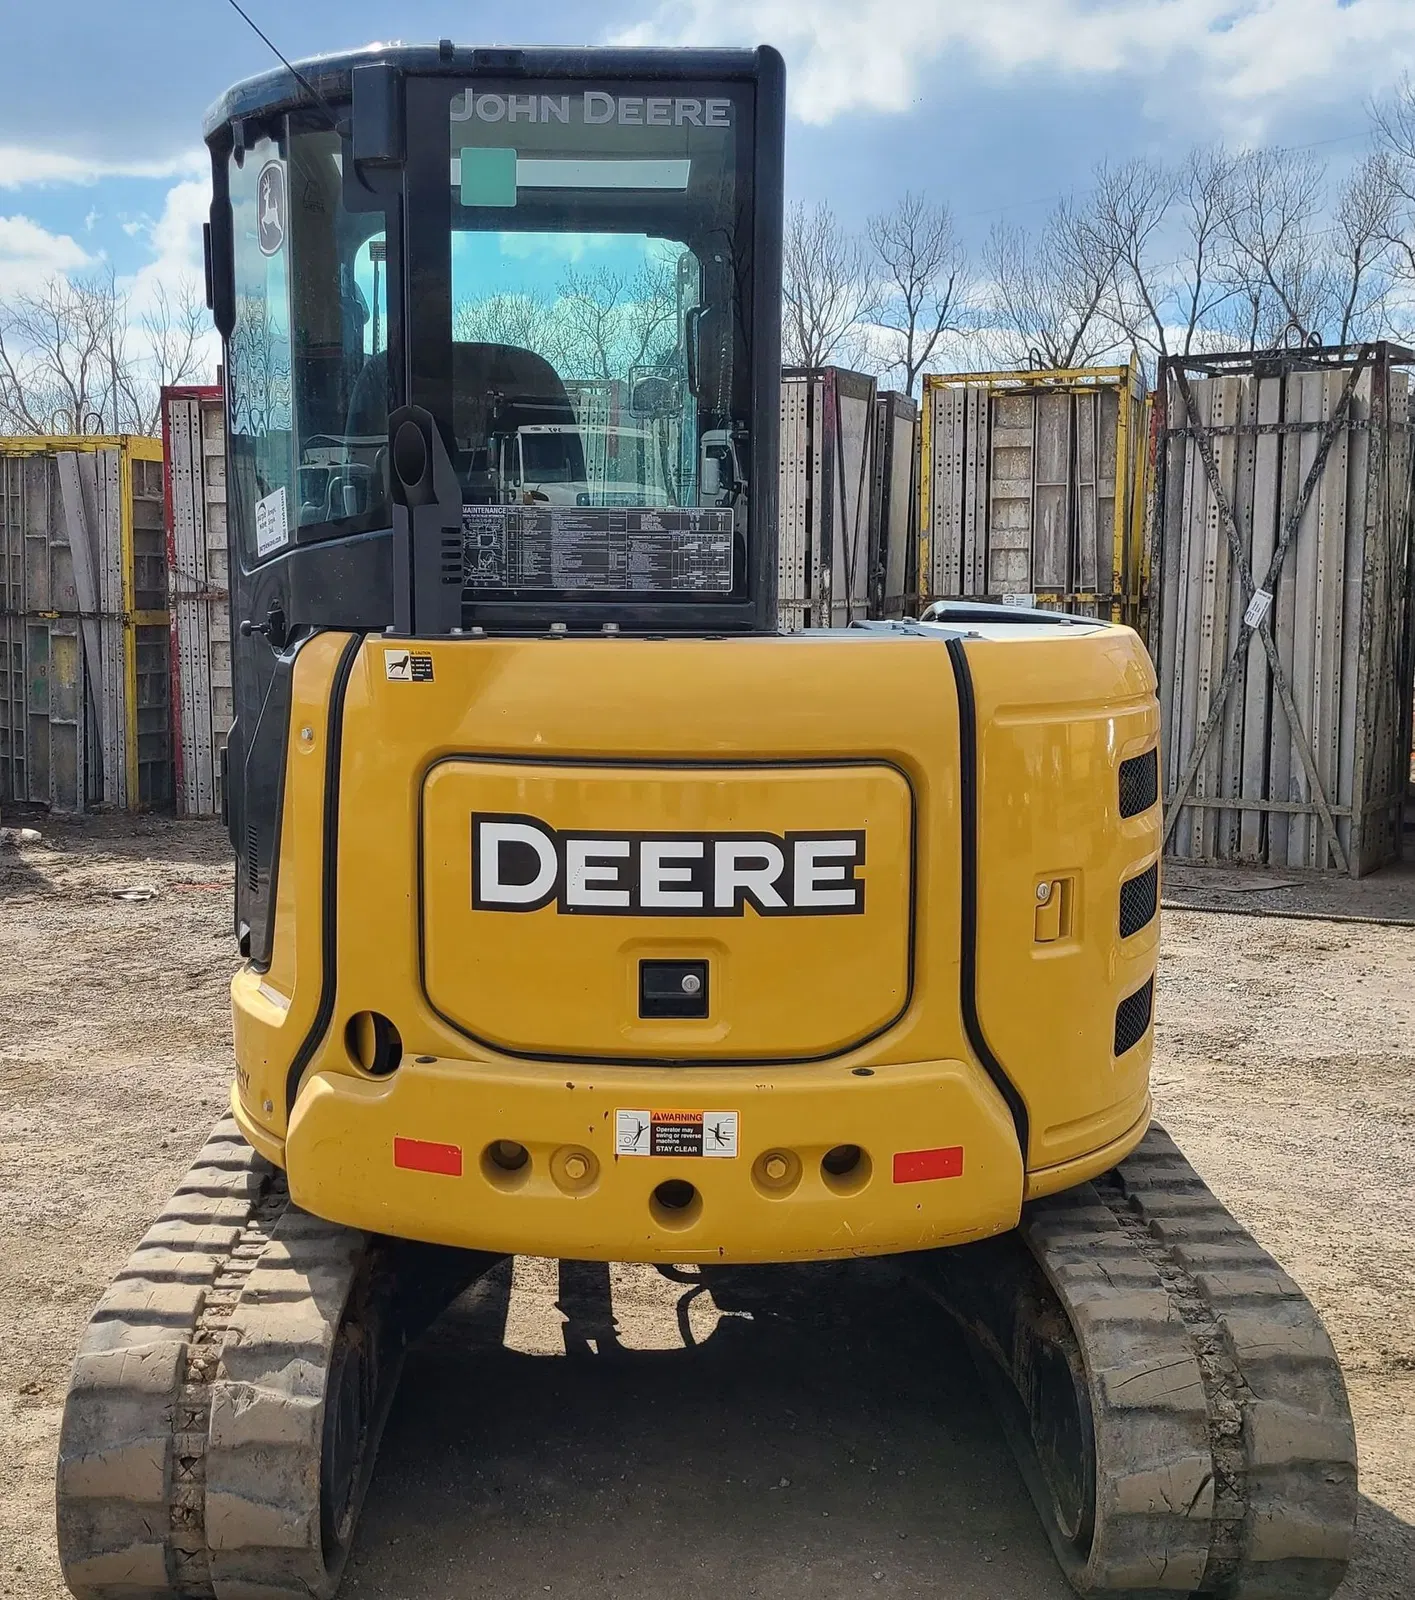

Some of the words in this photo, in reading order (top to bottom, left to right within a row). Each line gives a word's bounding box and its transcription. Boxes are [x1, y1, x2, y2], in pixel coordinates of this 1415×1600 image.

[450, 88, 570, 124] JOHN
[583, 91, 731, 127] DEERE
[479, 821, 858, 909] DEERE
[661, 1113, 702, 1121] WARNING
